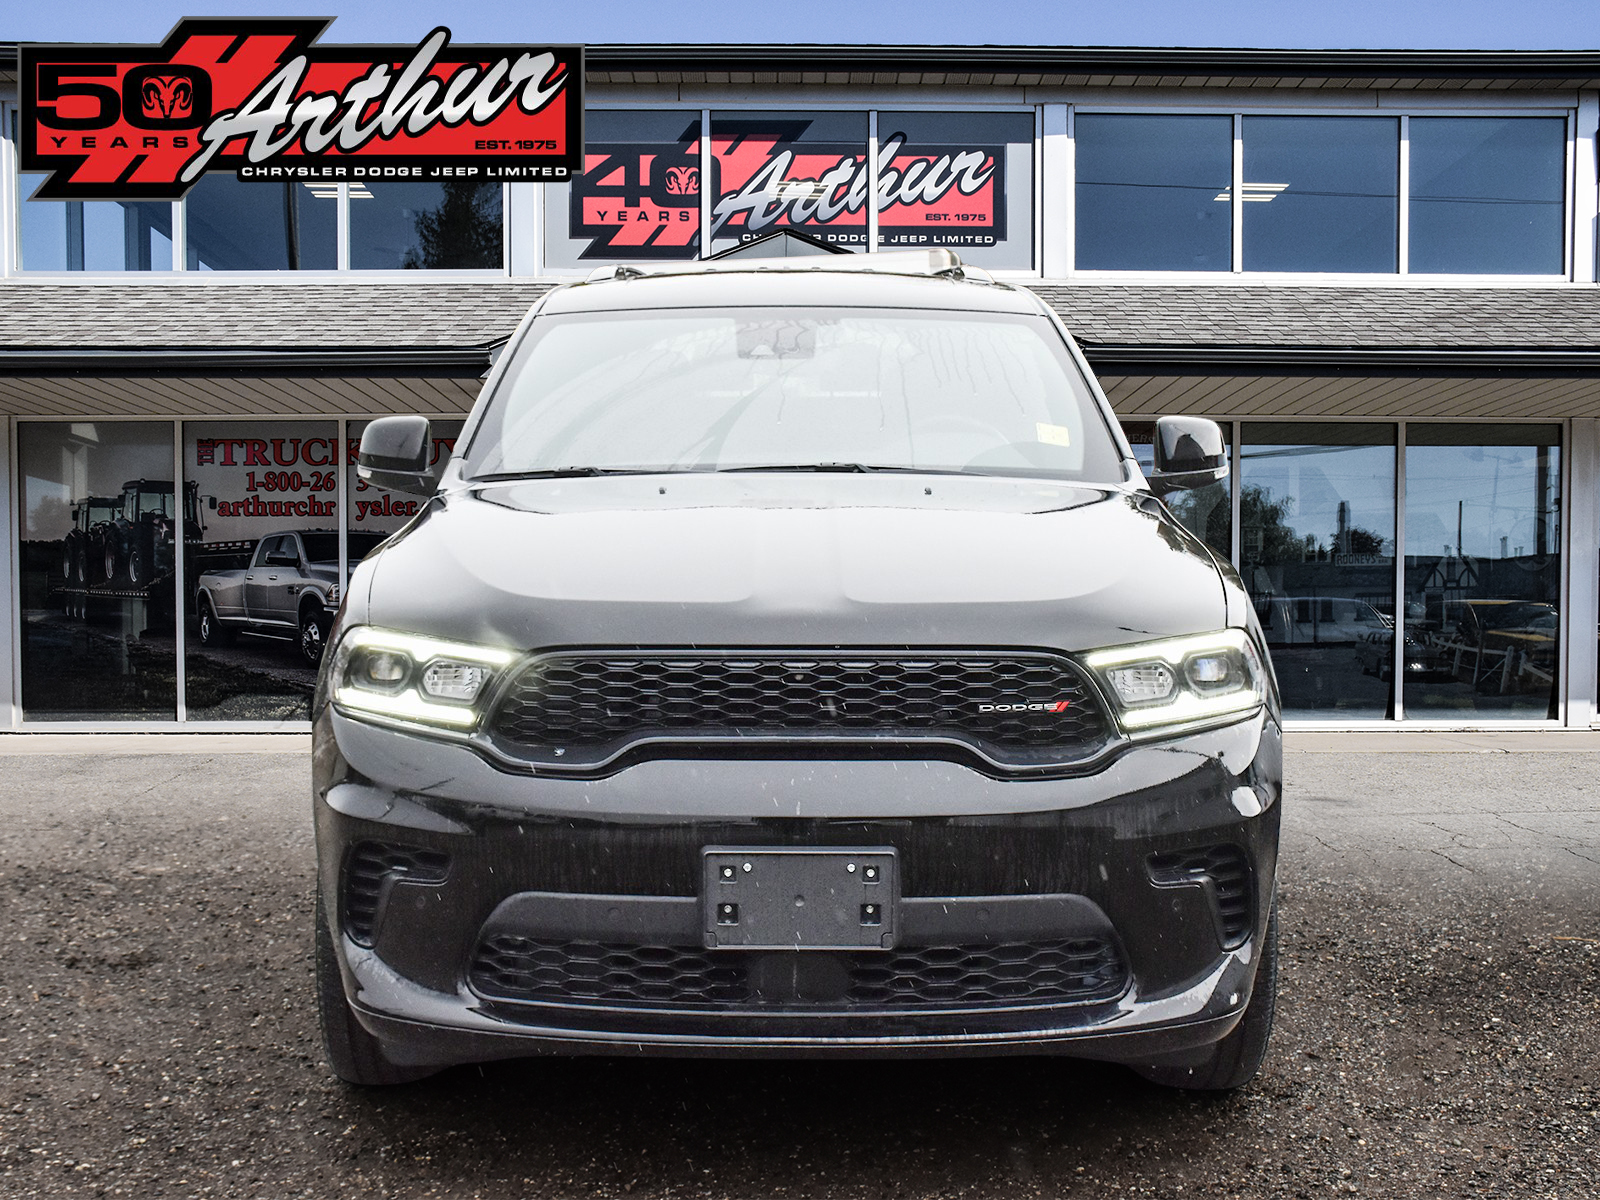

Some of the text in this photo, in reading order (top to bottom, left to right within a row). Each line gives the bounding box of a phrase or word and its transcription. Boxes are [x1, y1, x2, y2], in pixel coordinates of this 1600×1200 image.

[582, 154, 721, 208] 40
[692, 133, 996, 247] Arthur
[597, 210, 690, 222] YEARS
[925, 213, 987, 222] EST. 1975
[891, 235, 927, 243] JEEP
[933, 235, 994, 244] LIMITED
[197, 438, 214, 466] THE
[979, 703, 1058, 713] DODGE
